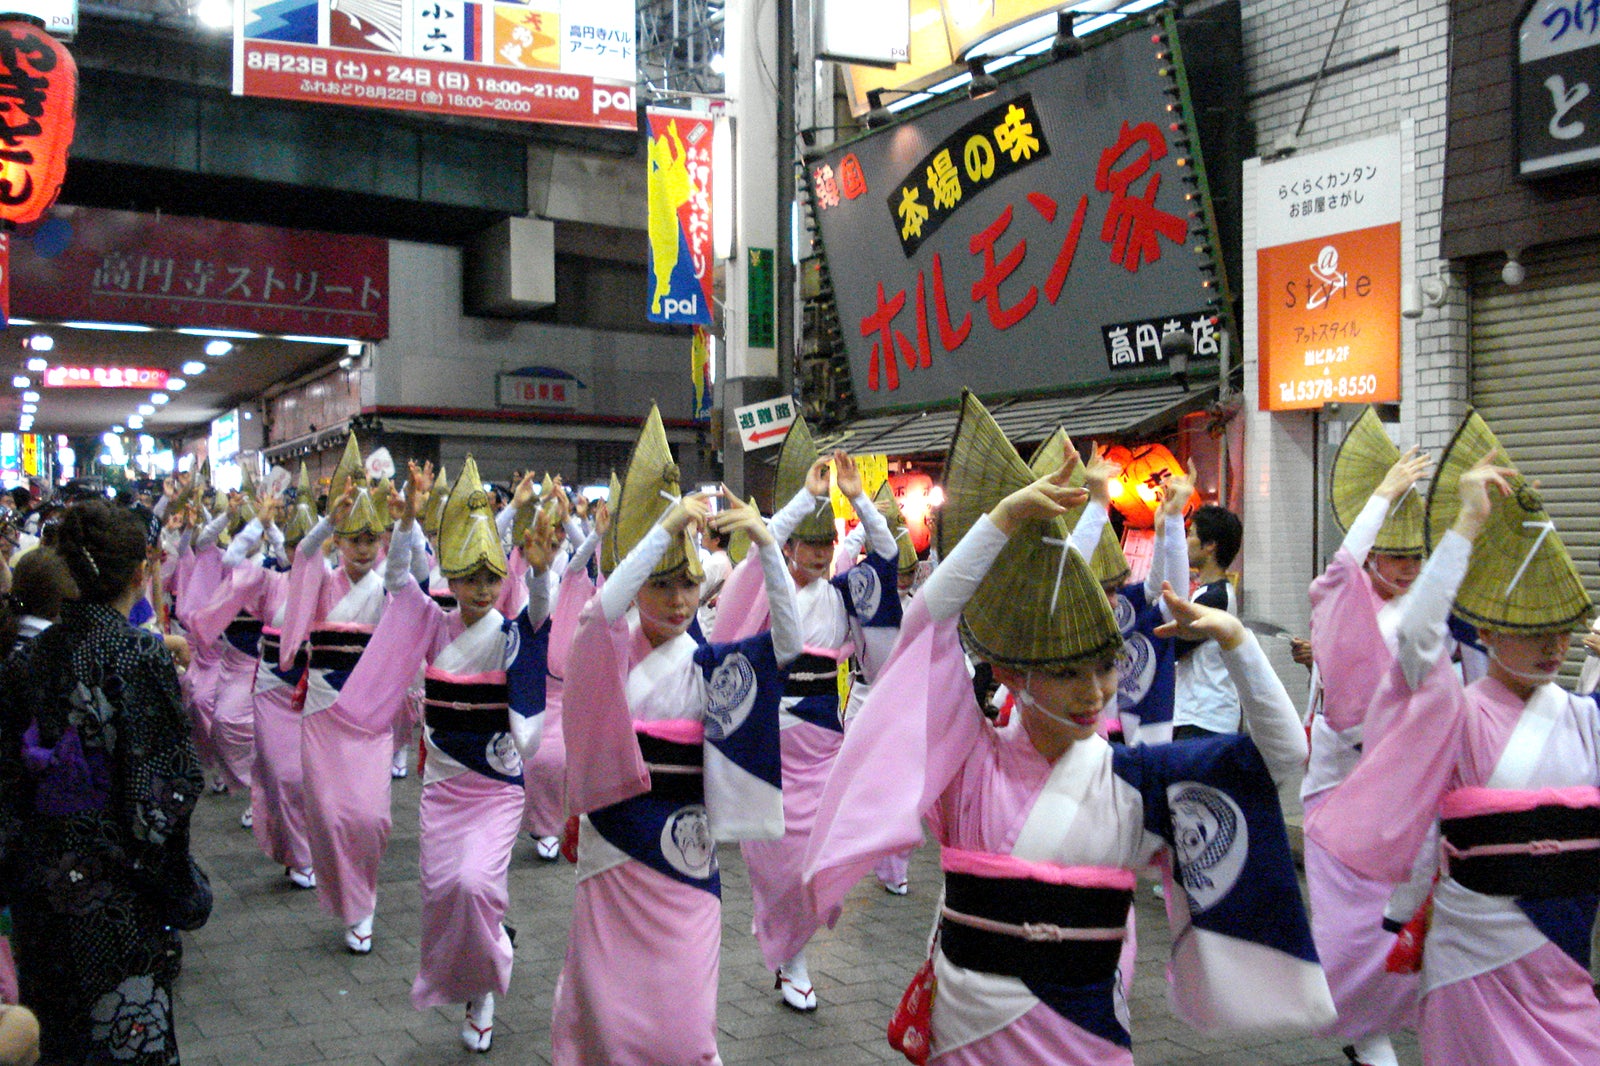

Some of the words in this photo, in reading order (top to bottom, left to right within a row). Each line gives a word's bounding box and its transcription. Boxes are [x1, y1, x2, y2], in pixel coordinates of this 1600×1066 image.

[51, 14, 76, 27] pal
[247, 51, 329, 77] 8月23日
[569, 41, 632, 60] アーケード
[592, 86, 637, 115] pal
[1543, 74, 1591, 140] と
[814, 151, 868, 210] 韓国
[897, 102, 1041, 242] 本場の味
[1278, 165, 1378, 200] らくらくカンタン
[1289, 189, 1365, 218] お部屋さがし
[859, 119, 1189, 392] ホルモン家
[91, 251, 382, 310] 高円寺ストリート
[664, 294, 698, 319] pal
[1294, 318, 1361, 344] アットスタイル
[739, 402, 792, 430] 避難路
